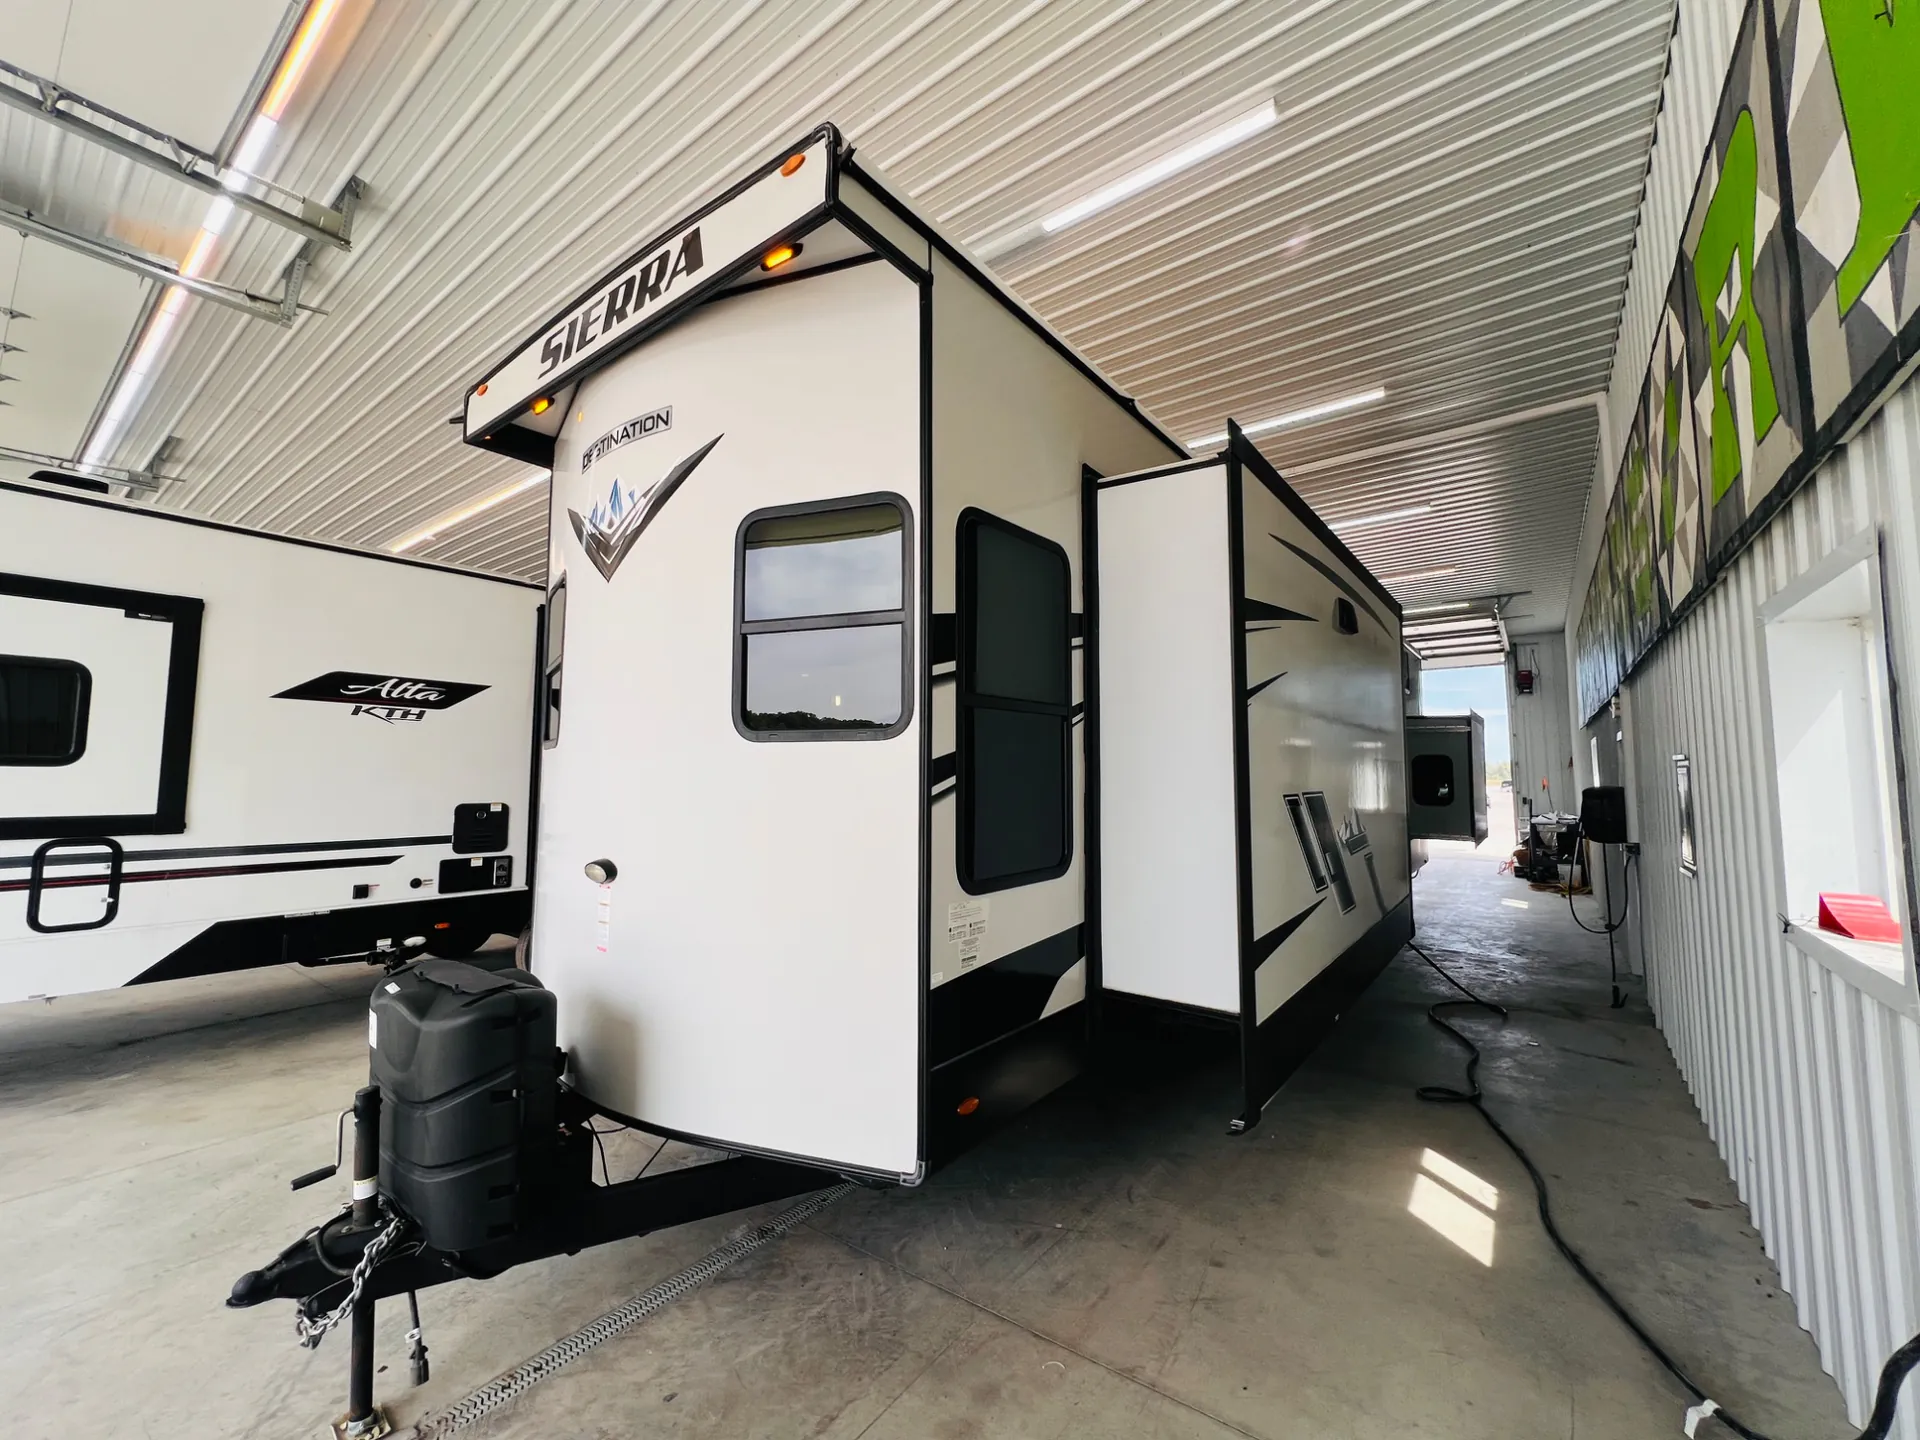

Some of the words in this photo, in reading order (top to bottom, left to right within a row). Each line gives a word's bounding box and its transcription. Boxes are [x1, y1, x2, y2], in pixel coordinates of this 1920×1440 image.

[537, 226, 704, 380] SIERRA
[582, 410, 670, 470] DESTINATION
[340, 678, 446, 701] Alta
[351, 705, 426, 725] KTH
